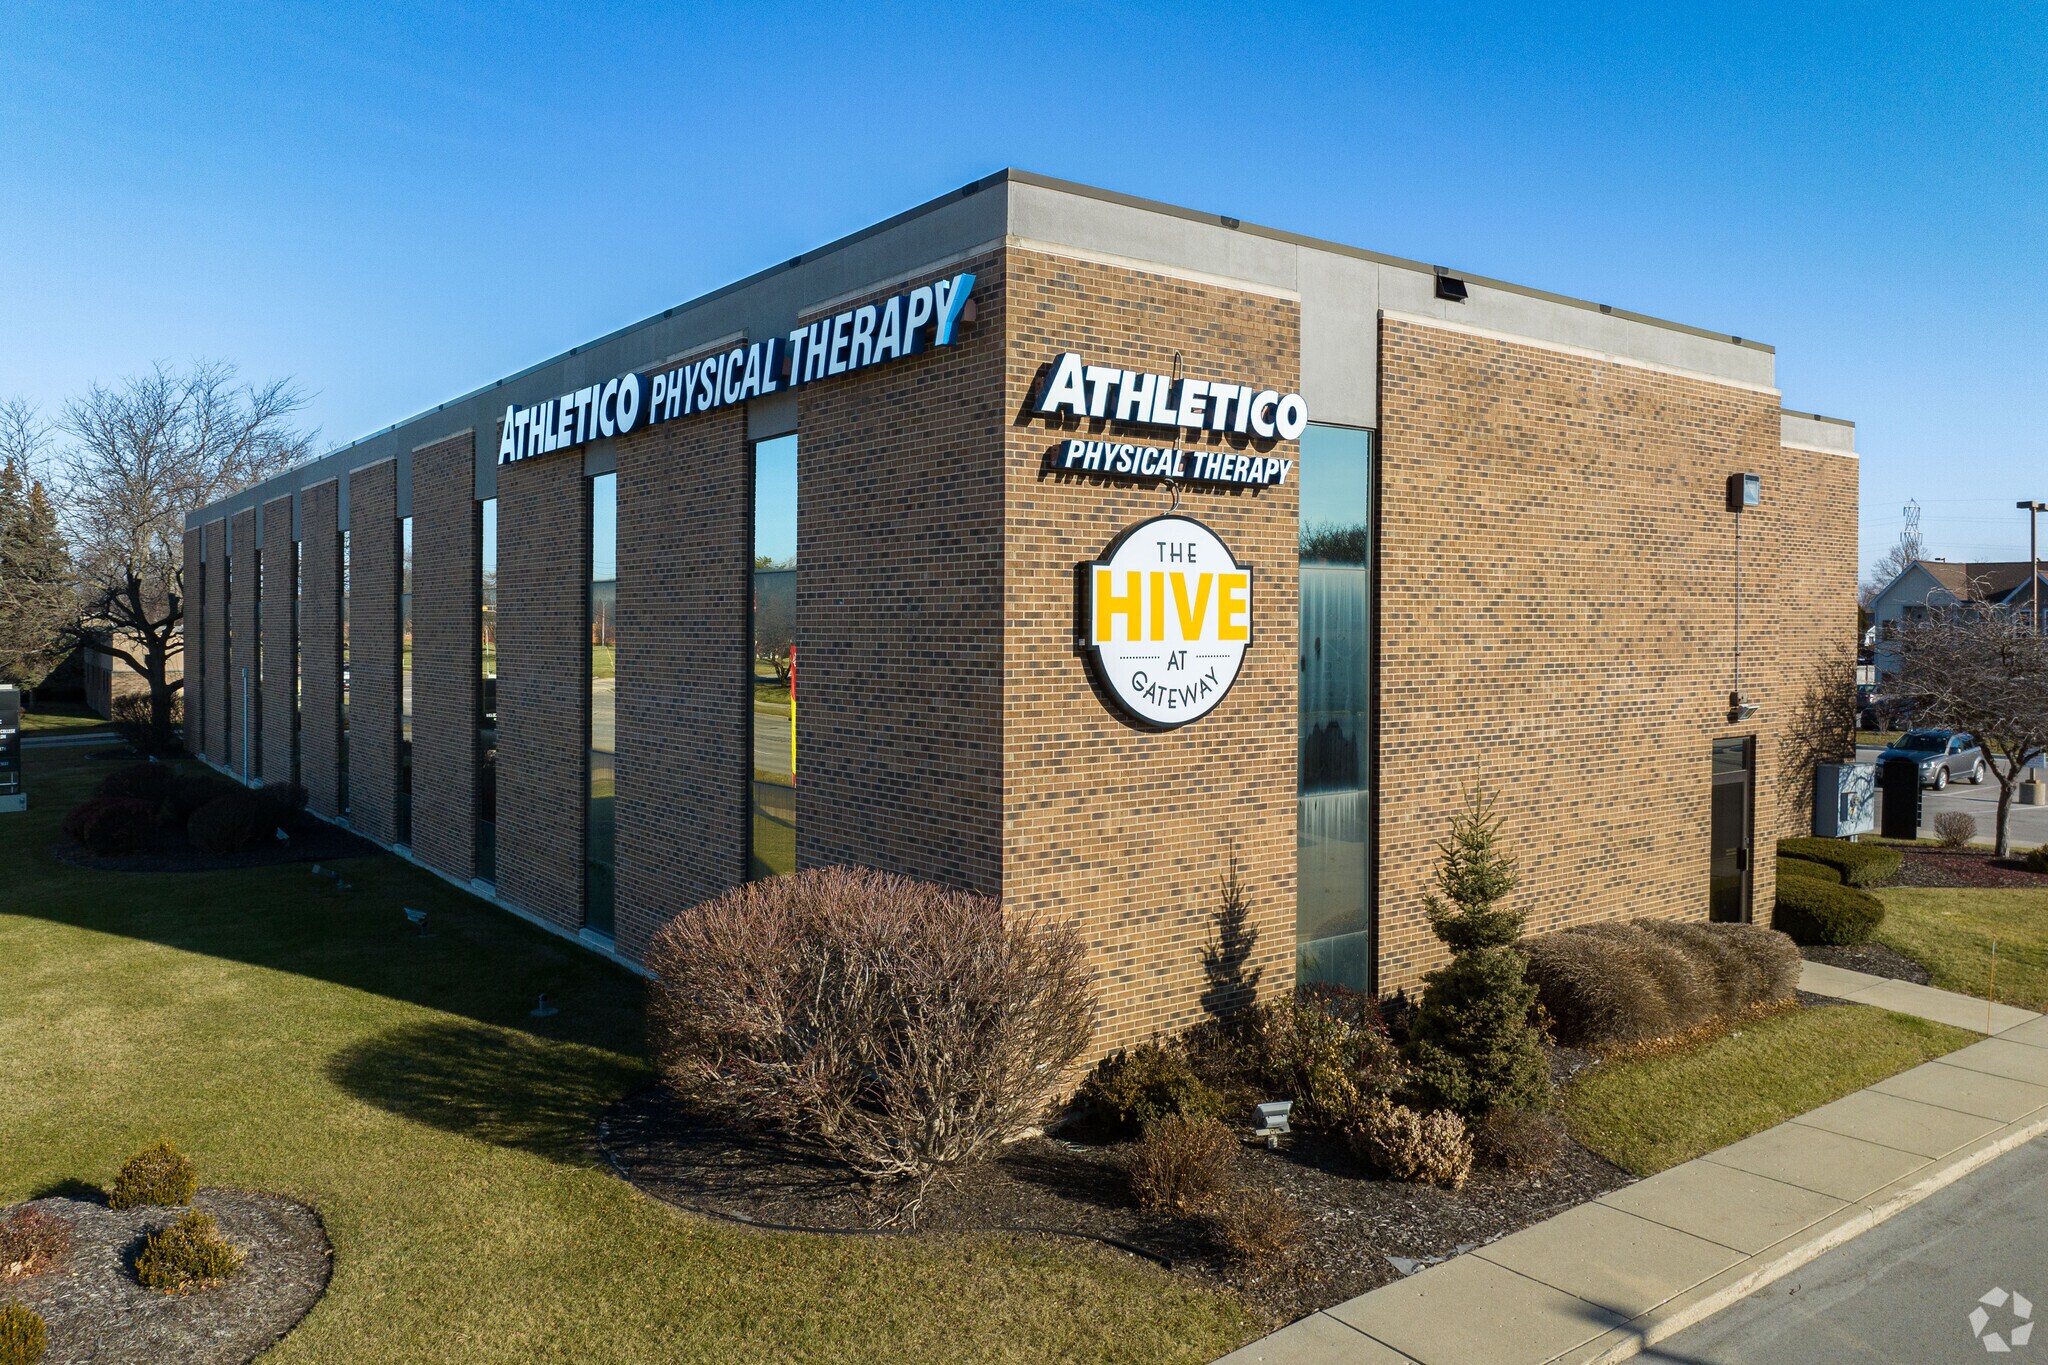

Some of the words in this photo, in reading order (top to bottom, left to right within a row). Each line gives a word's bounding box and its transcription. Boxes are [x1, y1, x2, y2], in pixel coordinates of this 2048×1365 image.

[498, 372, 645, 465] ATHLETICO
[649, 338, 783, 425] PHYSICAL
[788, 273, 976, 386] THERAPY
[1038, 352, 1308, 441] ATHLETICO
[1063, 440, 1184, 478] PHYSICAL
[1193, 450, 1294, 485] THERAPY
[1156, 541, 1197, 563] THE
[1096, 570, 1248, 642] HIVE
[1167, 650, 1187, 671] AT
[1131, 666, 1219, 709] GATEWAY
